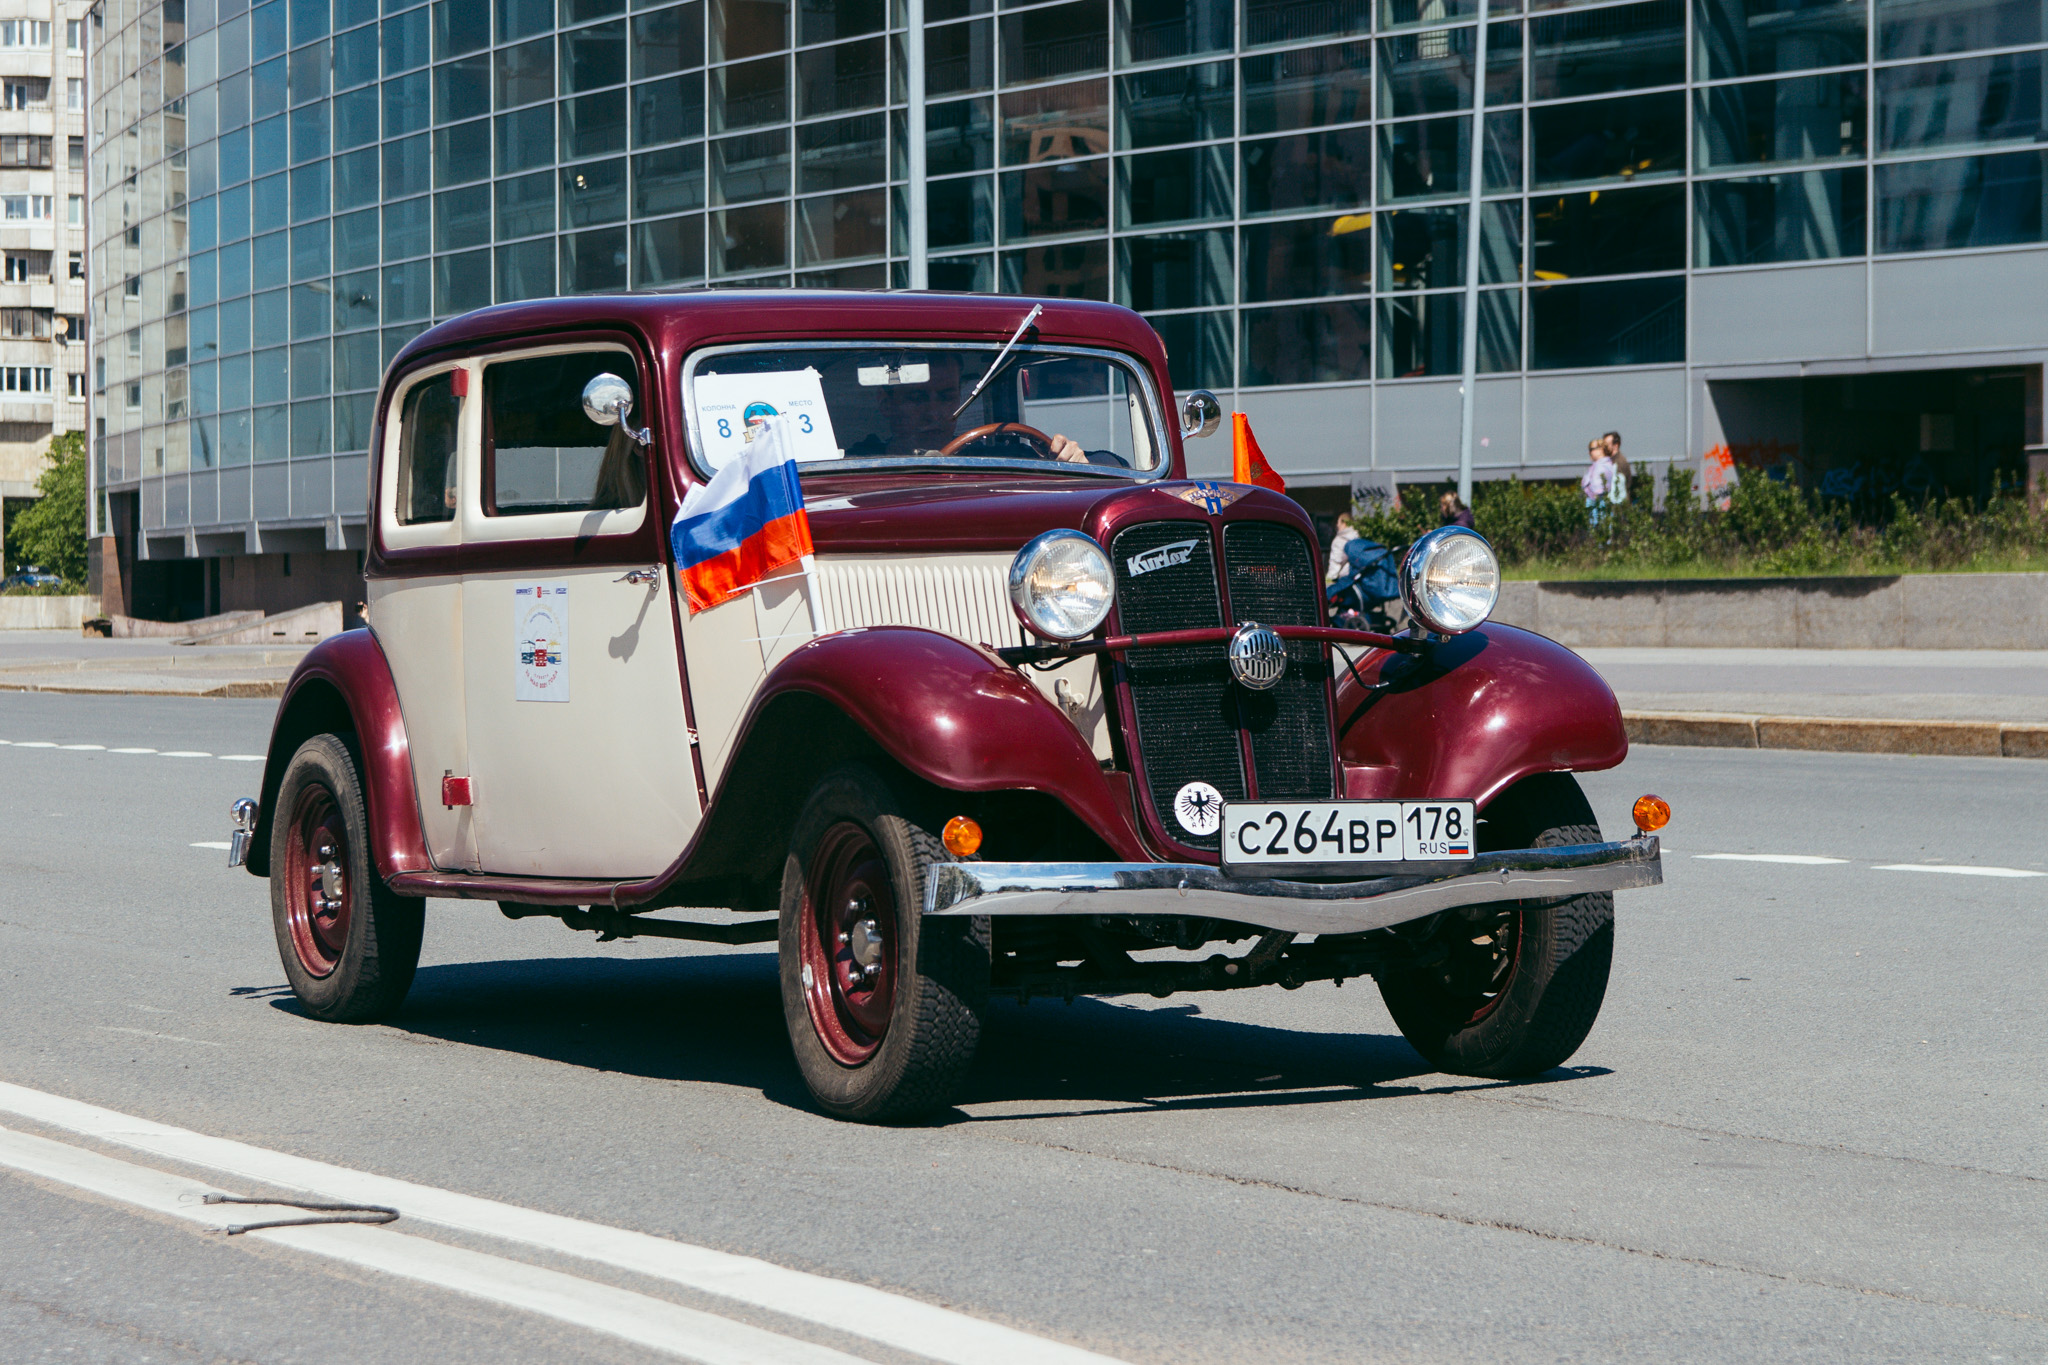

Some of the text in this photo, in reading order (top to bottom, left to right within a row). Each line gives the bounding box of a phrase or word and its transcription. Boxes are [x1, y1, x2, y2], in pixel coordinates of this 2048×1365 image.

[717, 414, 813, 439] 8 3
[1237, 809, 1397, 856] С264ВР
[1406, 807, 1463, 841] 178
[1419, 842, 1448, 855] RUS
